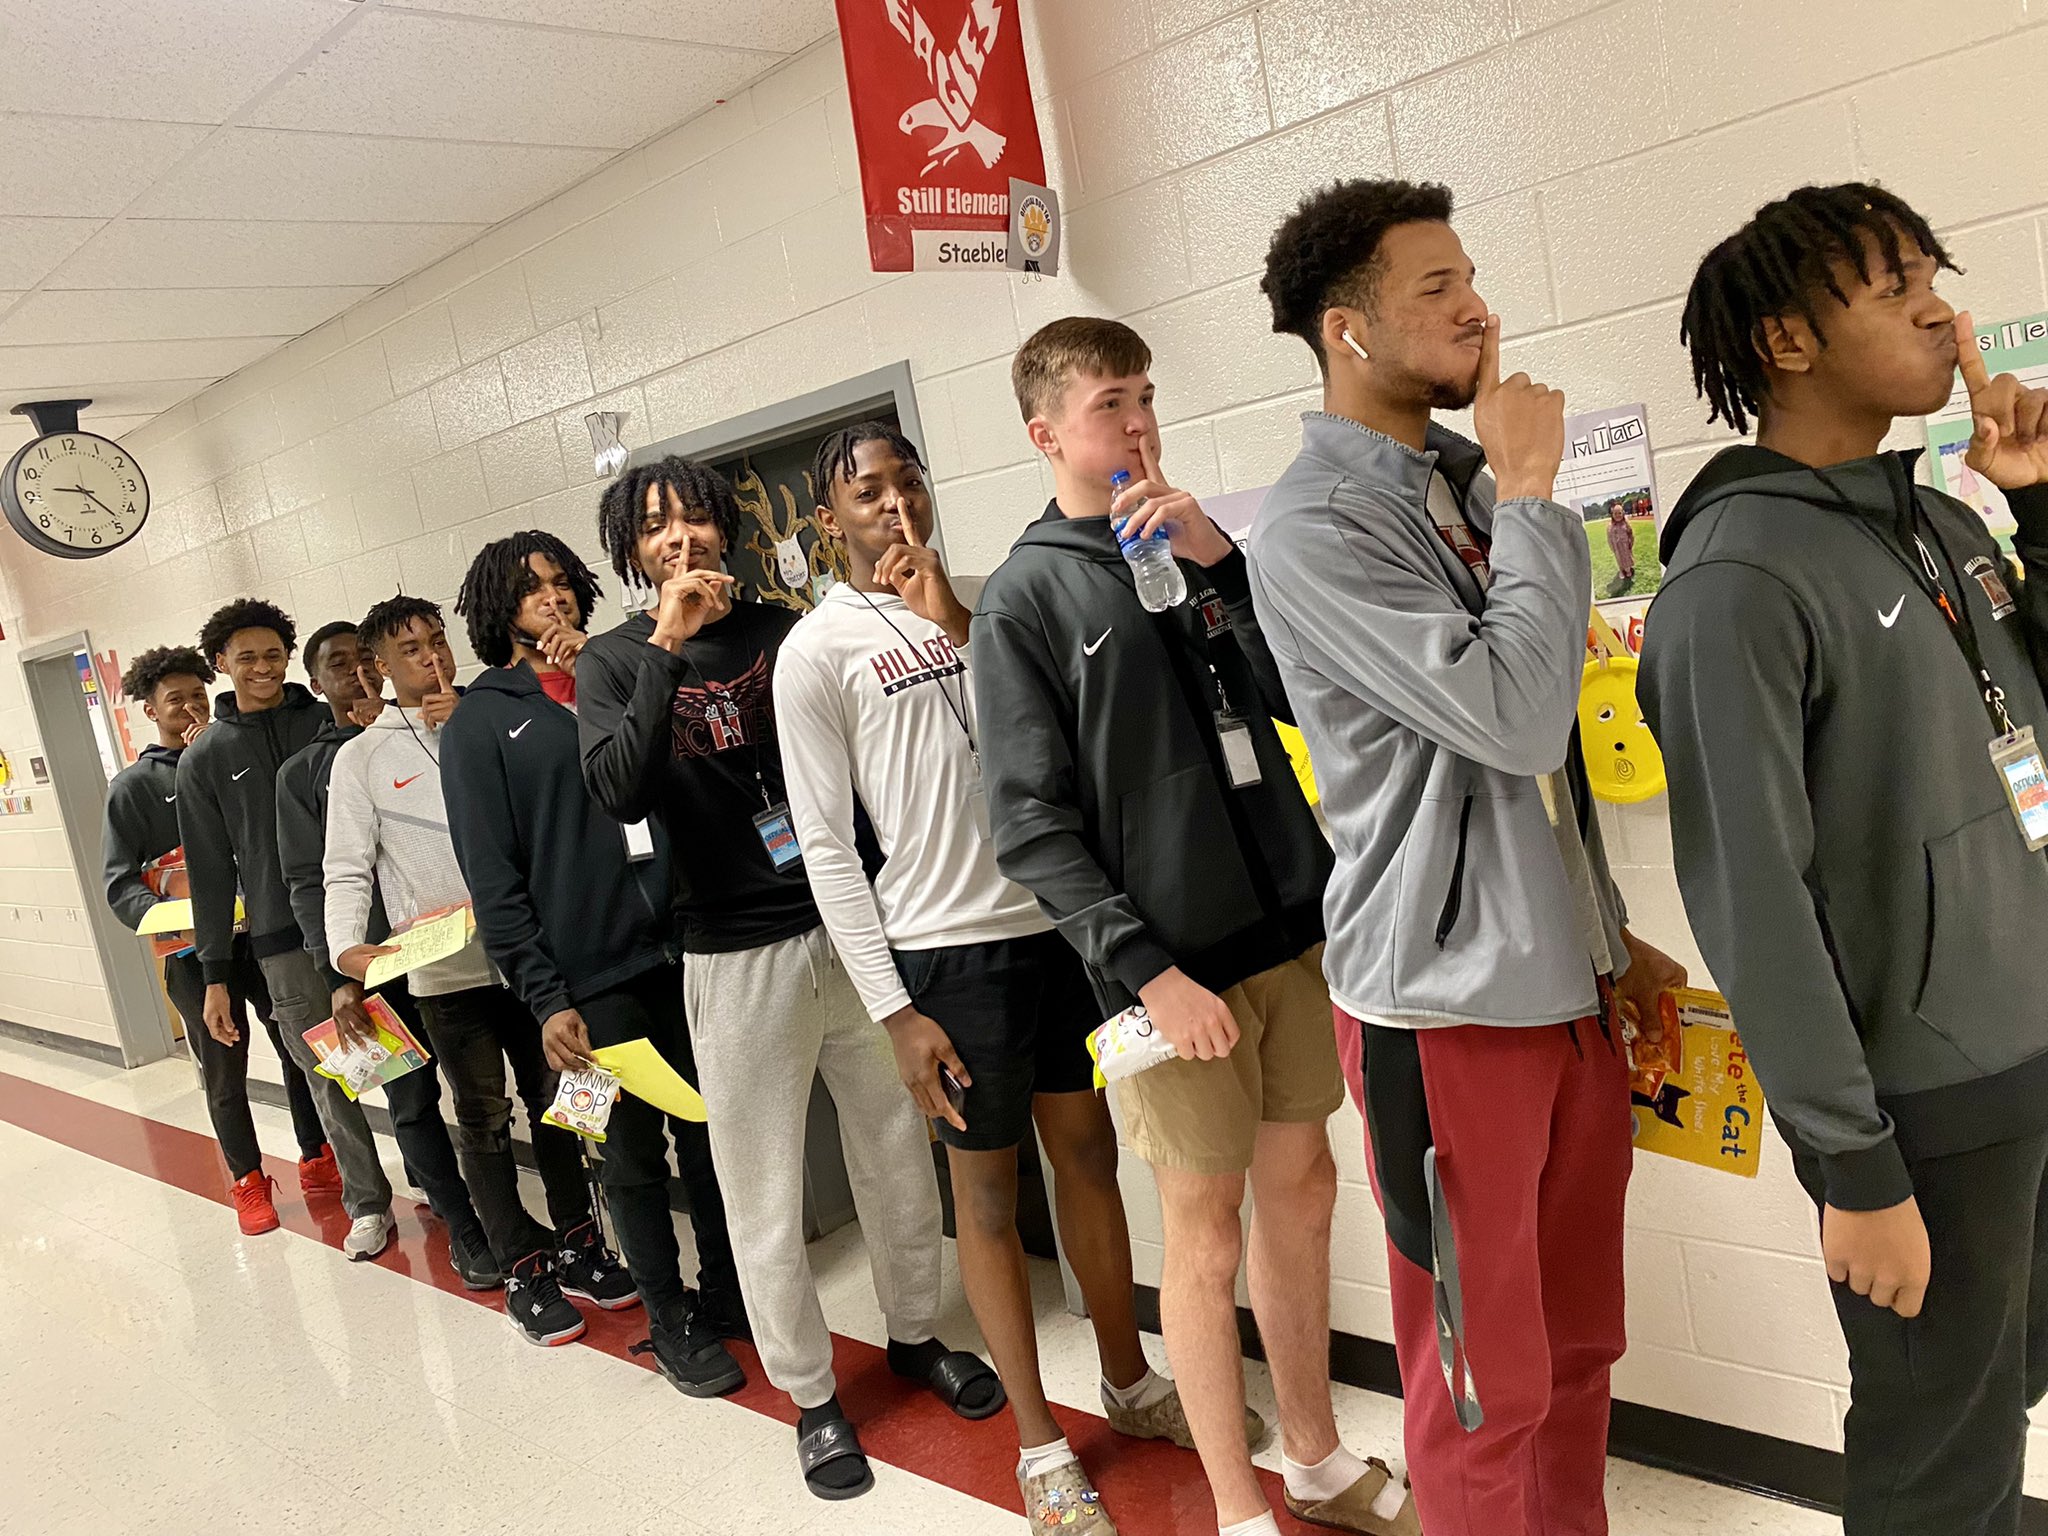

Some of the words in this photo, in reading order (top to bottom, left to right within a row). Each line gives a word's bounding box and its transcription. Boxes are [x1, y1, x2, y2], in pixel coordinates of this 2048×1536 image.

[897, 187, 941, 214] Still
[946, 187, 1008, 215] Elemen
[61, 438, 77, 451] 12
[94, 443, 100, 455] 1
[38, 447, 49, 460] 11
[114, 456, 125, 469] 2
[23, 467, 37, 480] 10
[127, 479, 137, 492] 3
[24, 490, 36, 504] 9
[126, 501, 137, 514] 4
[39, 514, 51, 529] 8
[114, 522, 124, 535] 5
[64, 530, 73, 542] 7
[91, 531, 102, 544] 6
[558, 1080, 608, 1115] POP
[1736, 1083, 1748, 1104] the
[1720, 1105, 1750, 1158] Cat
